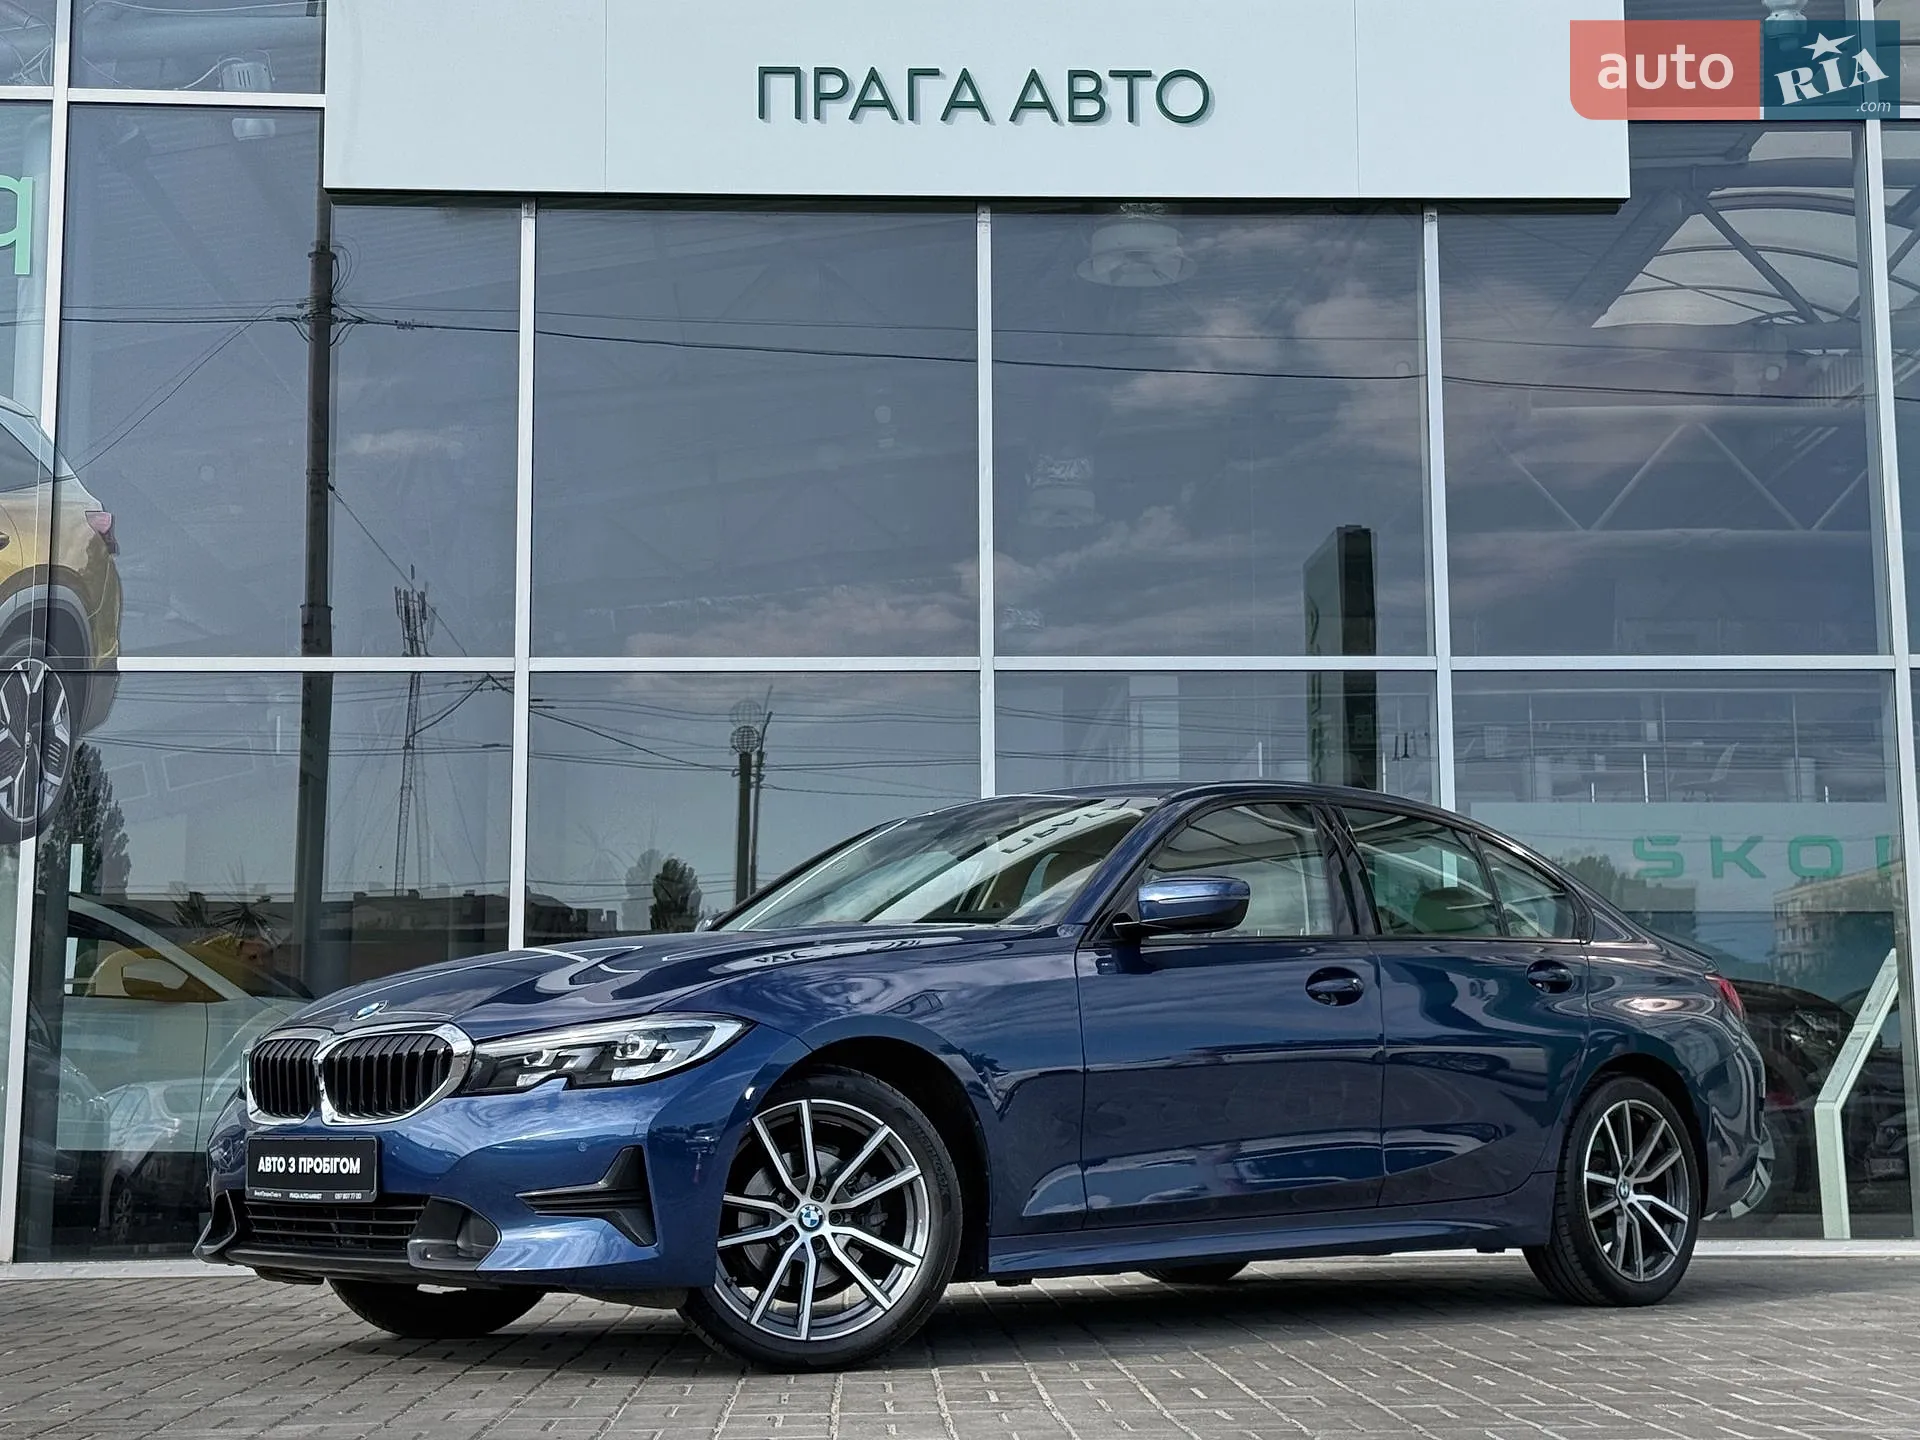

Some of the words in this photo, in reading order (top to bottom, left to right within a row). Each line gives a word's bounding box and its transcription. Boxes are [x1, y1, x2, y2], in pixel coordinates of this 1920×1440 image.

[758, 66, 992, 122] ПРАГА
[1009, 68, 1212, 124] АВТО
[1633, 835, 1894, 879] SKO
[257, 1156, 286, 1173] АВТО
[298, 1157, 361, 1174] ПРОБІГОМ
